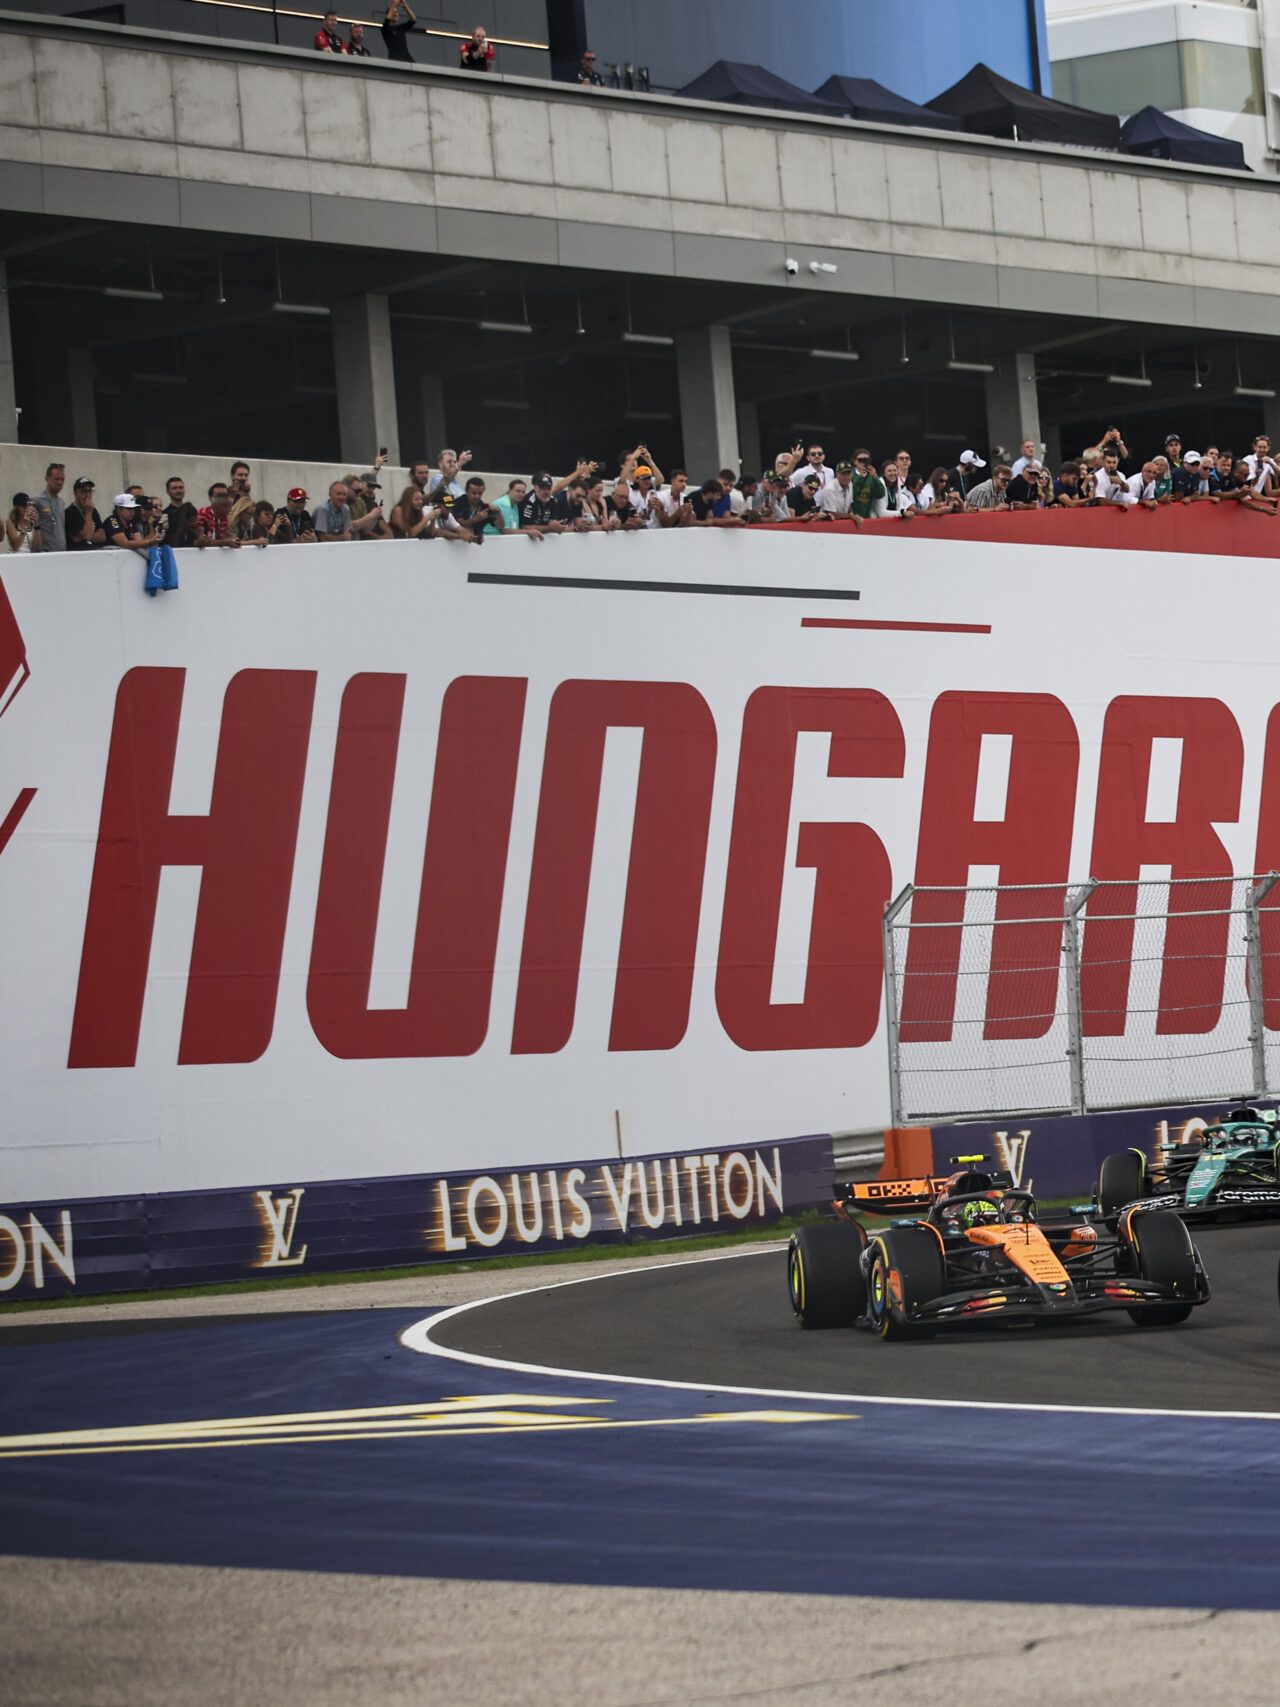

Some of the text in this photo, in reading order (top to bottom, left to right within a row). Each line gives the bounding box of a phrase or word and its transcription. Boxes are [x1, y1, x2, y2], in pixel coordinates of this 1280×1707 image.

[437, 1146, 784, 1252] LOUIS VUITTON
[867, 1183, 912, 1197] OKX
